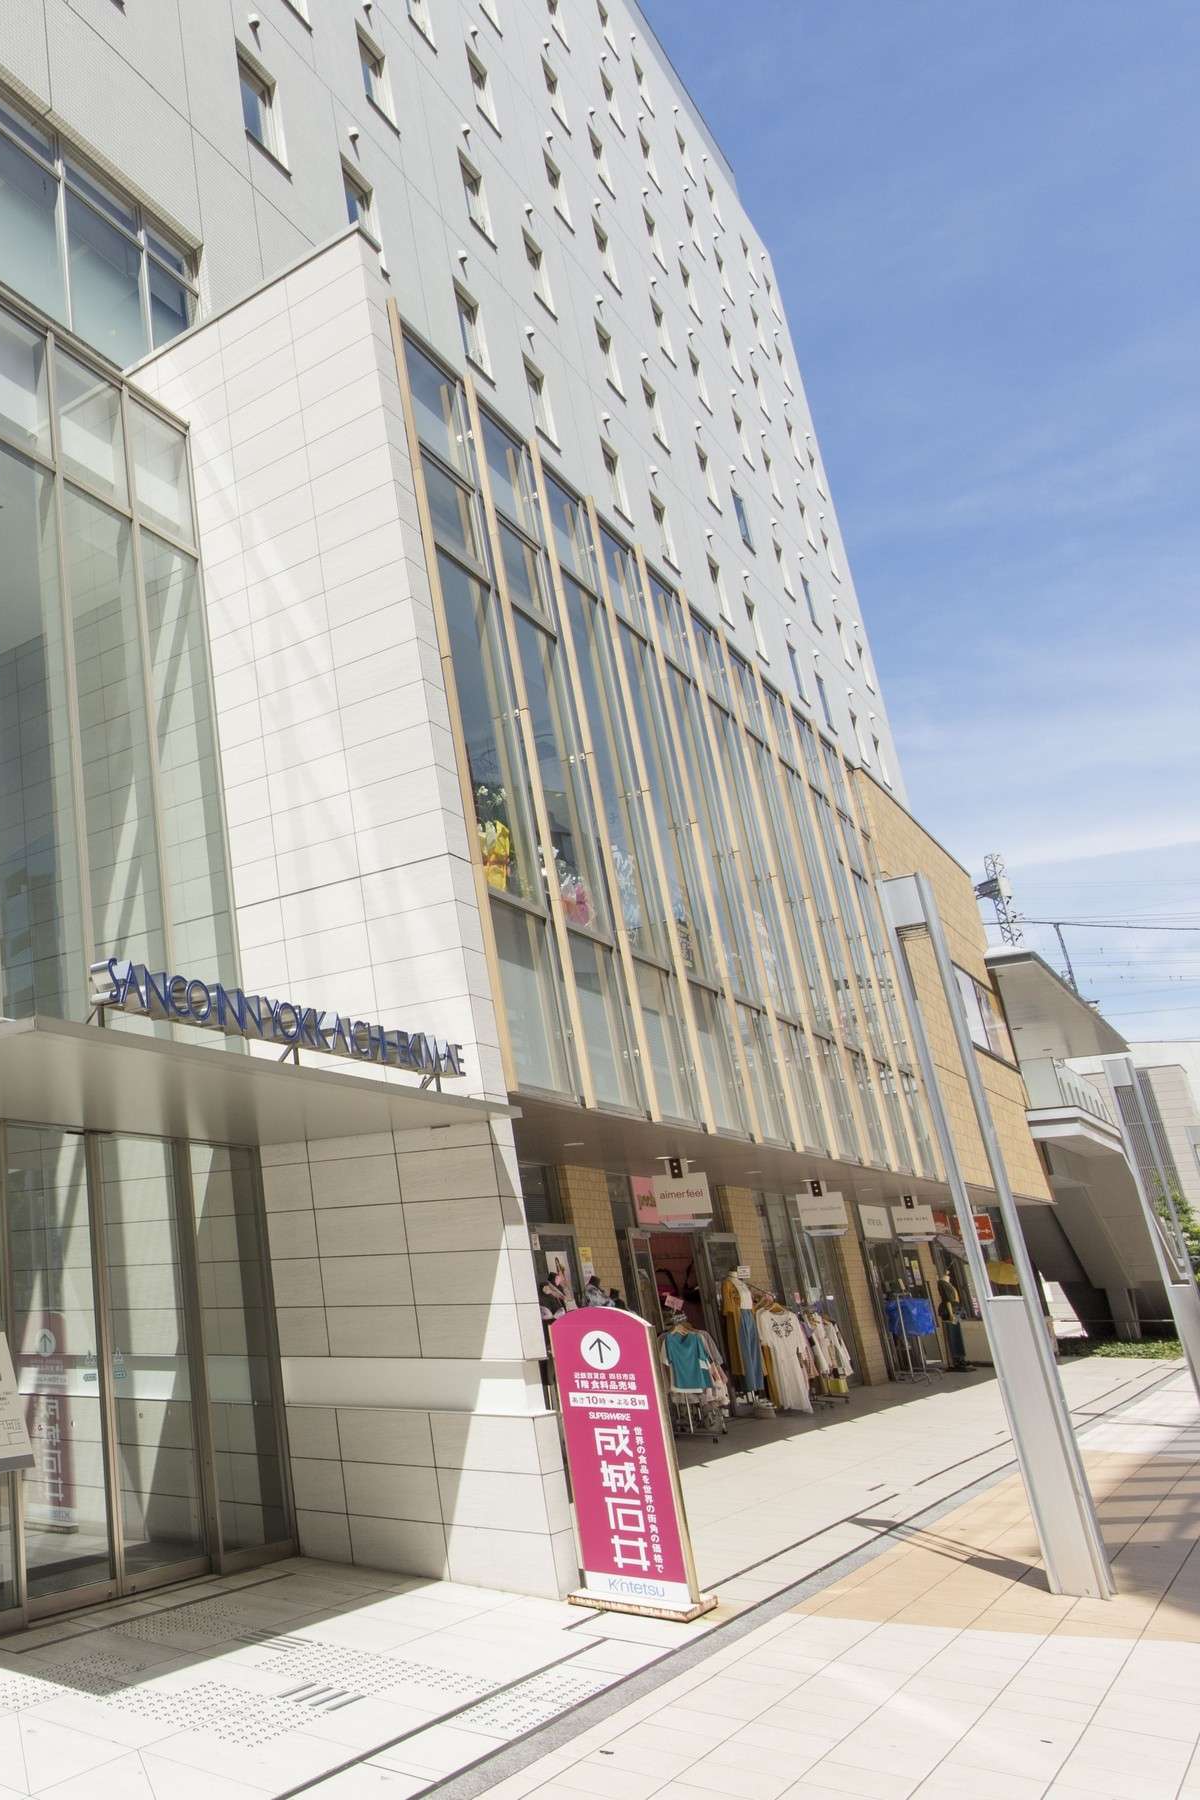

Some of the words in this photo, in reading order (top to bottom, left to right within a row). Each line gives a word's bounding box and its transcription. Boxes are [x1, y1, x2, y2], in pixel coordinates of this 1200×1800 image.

[91, 957, 212, 1022] SANCO
[659, 1188, 704, 1200] aimerfeel
[594, 1425, 650, 1571] 成城石井
